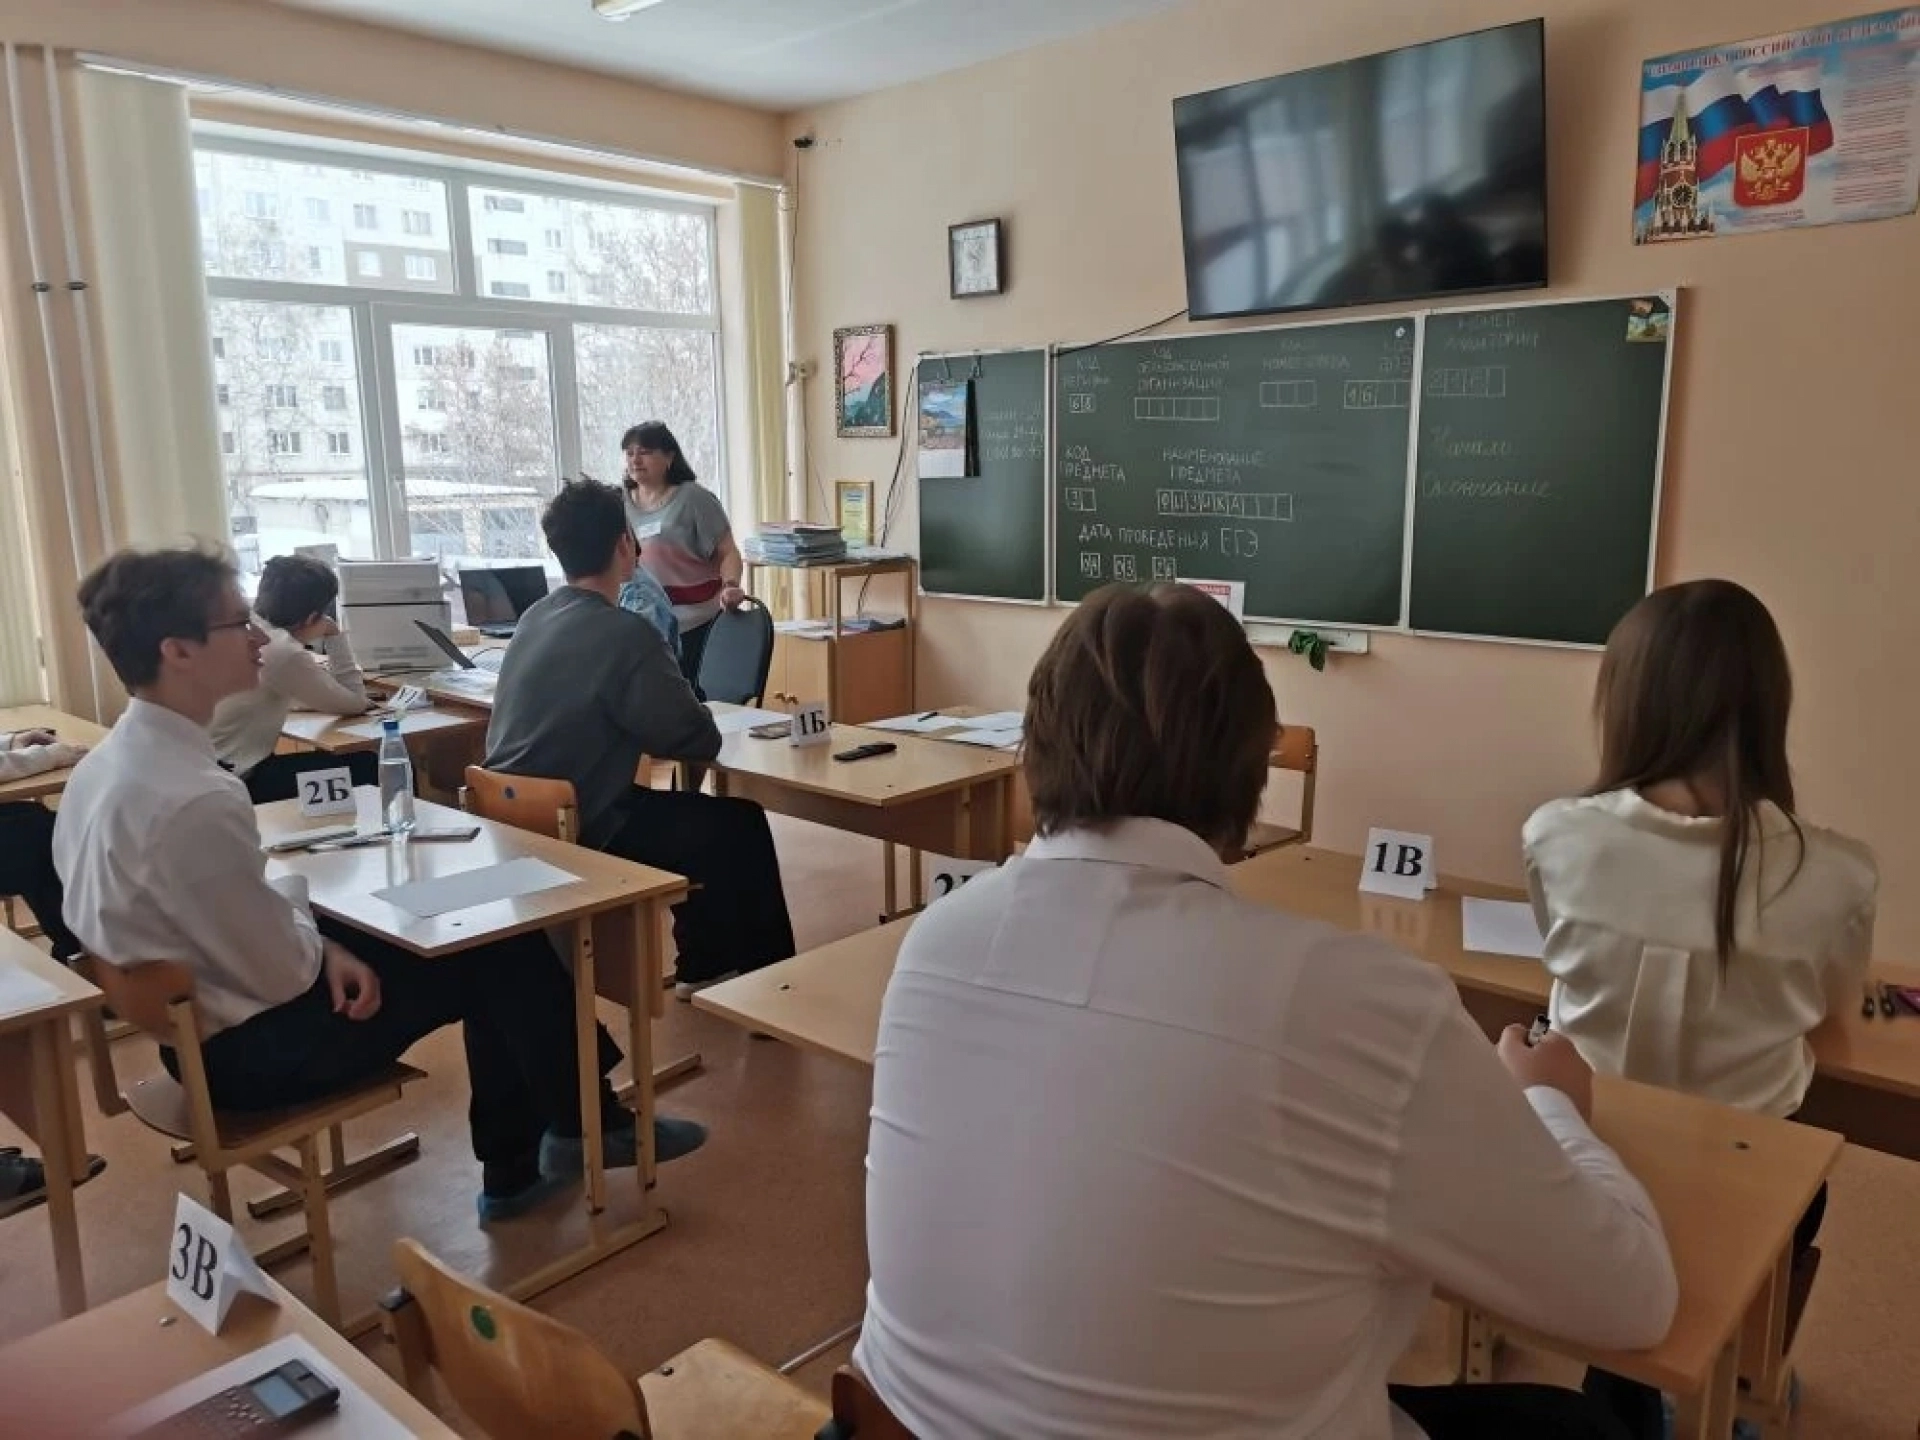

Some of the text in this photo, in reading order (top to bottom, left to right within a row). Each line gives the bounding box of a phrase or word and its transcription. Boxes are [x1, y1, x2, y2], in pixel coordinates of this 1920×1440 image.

[1065, 445, 1091, 462] КОД
[1079, 523, 1113, 544] ДАТА
[1220, 527, 1260, 557] ЕГЭ
[798, 710, 827, 736] 1Б
[304, 777, 350, 805] 2Б
[1370, 842, 1424, 876] 1В
[934, 872, 975, 897] 2
[172, 1222, 218, 1301] 3В
